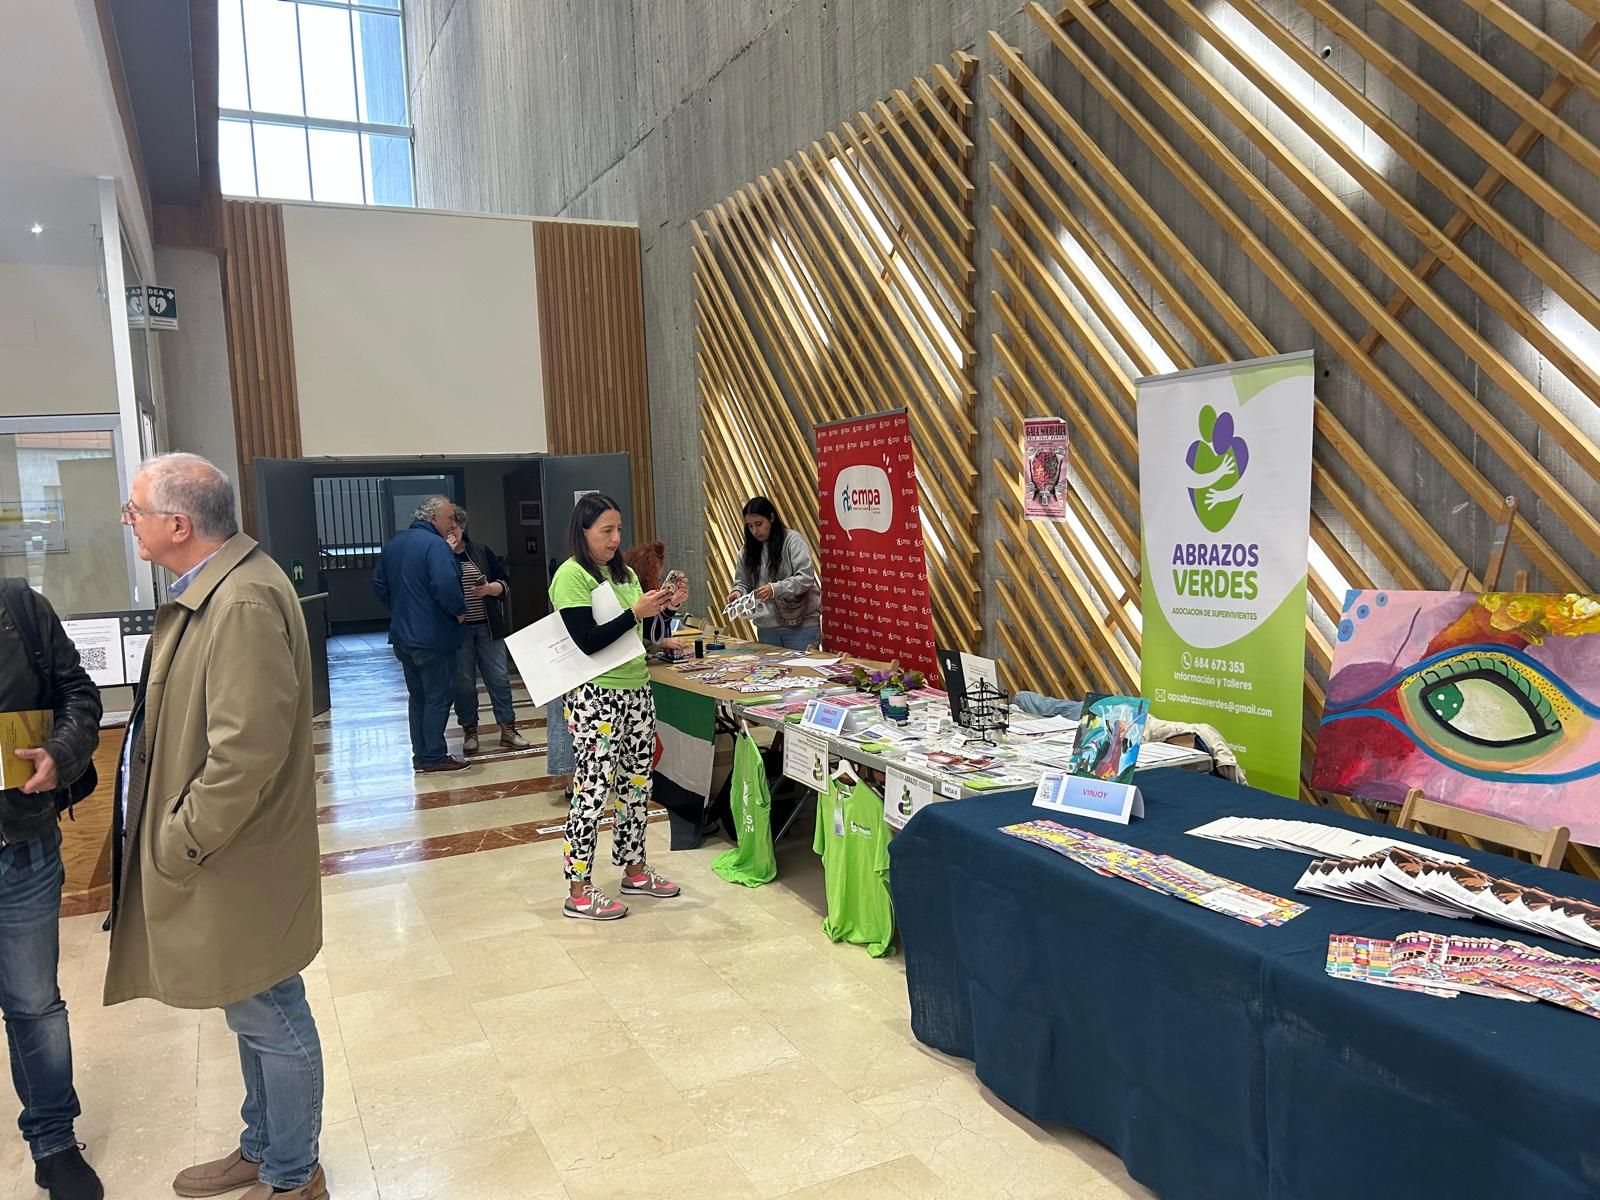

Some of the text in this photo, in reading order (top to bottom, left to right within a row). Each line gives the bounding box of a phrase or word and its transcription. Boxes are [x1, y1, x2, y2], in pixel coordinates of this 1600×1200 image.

[148, 288, 164, 296] DEA
[851, 488, 881, 511] cmpa
[1172, 543, 1259, 567] ABRAZOS
[1172, 568, 1258, 600] VERDES
[1203, 609, 1211, 617] DE
[1211, 609, 1257, 620] SUPERVIVIENTES
[1194, 656, 1245, 674] 684 673 353
[1174, 671, 1252, 690] Información y Talleres
[1082, 788, 1109, 799] VINJOY
